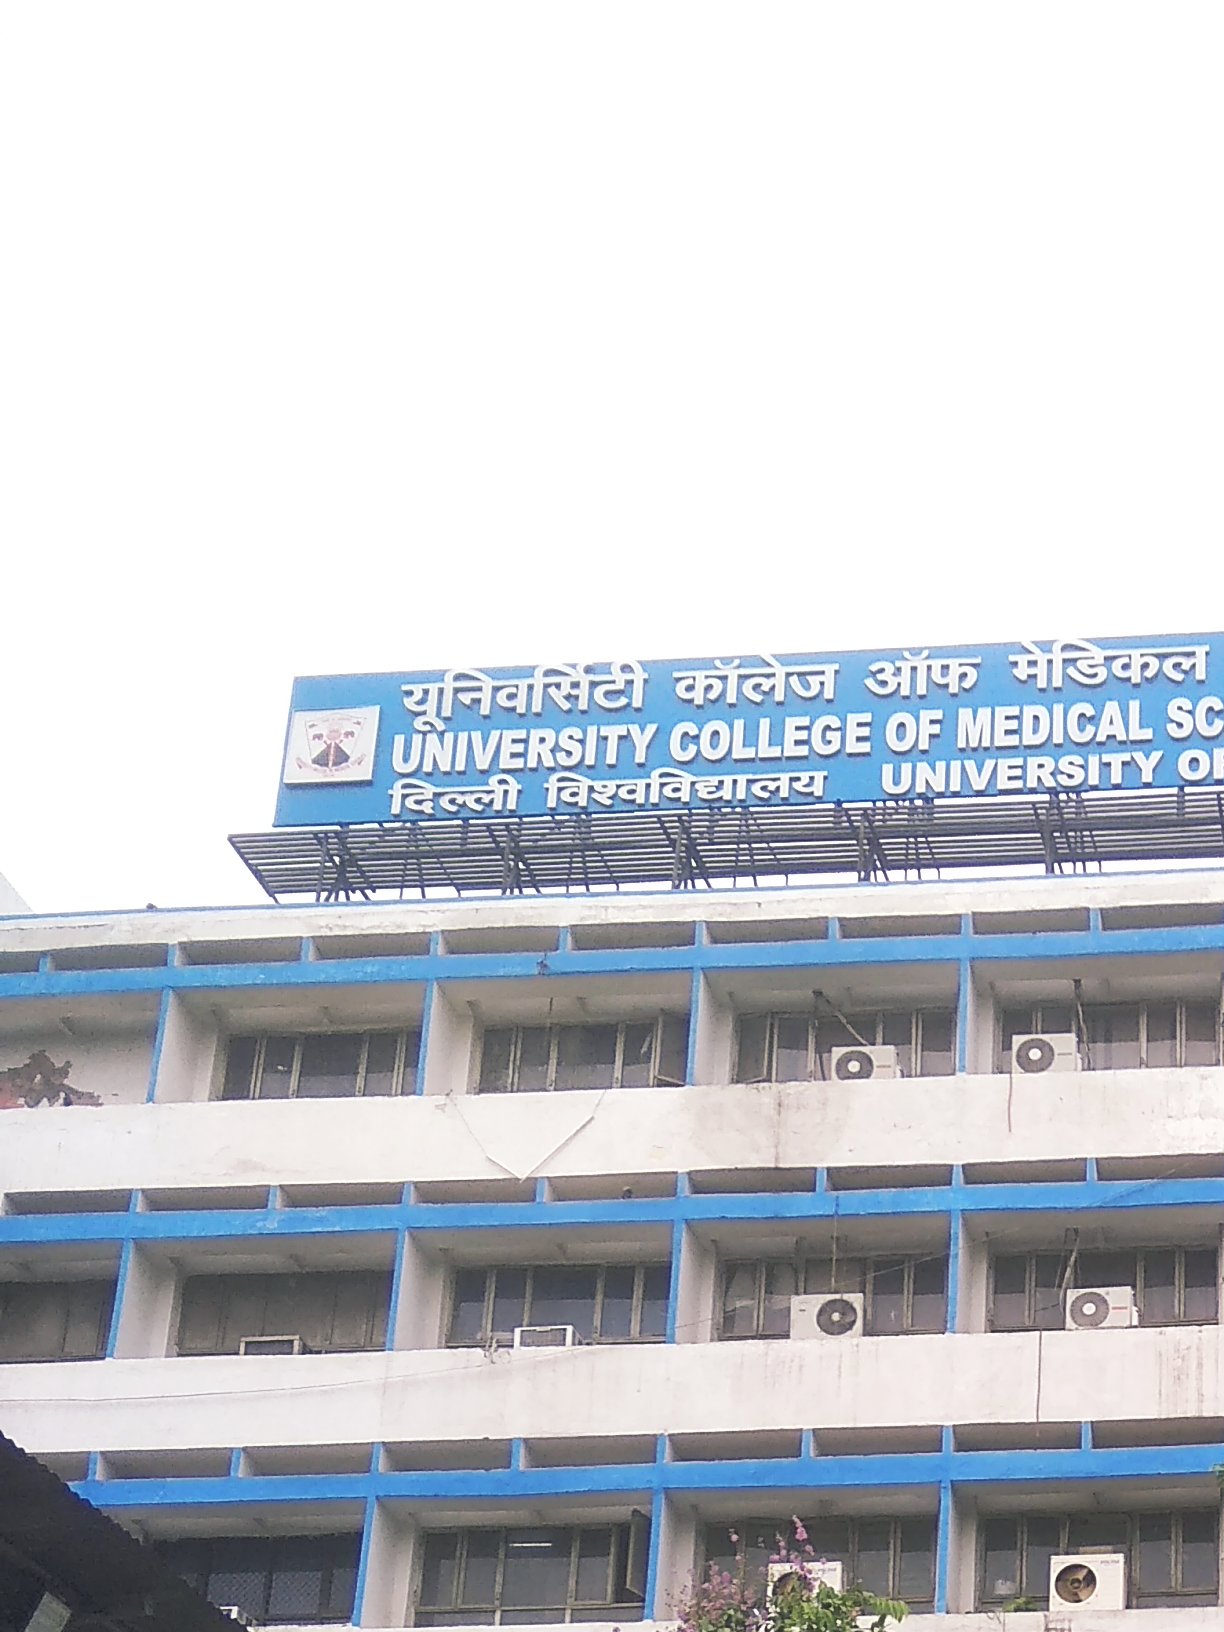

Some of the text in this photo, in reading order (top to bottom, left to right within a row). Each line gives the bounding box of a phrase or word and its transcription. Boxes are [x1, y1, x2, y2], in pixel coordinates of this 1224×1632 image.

[401, 660, 649, 732] यूनिवर्सिटी
[672, 654, 839, 706] कॉलेज
[864, 650, 982, 699] ऑफ
[1008, 640, 1210, 690] मेडिकल
[391, 723, 658, 774] UNIVERSITY
[669, 712, 873, 762] COLLEGE
[885, 709, 944, 752] OF
[957, 700, 1154, 749] MEDICAL
[388, 768, 828, 815] दिल्ली विश्वविद्यालय
[881, 750, 1164, 795] UNIVERSITY
